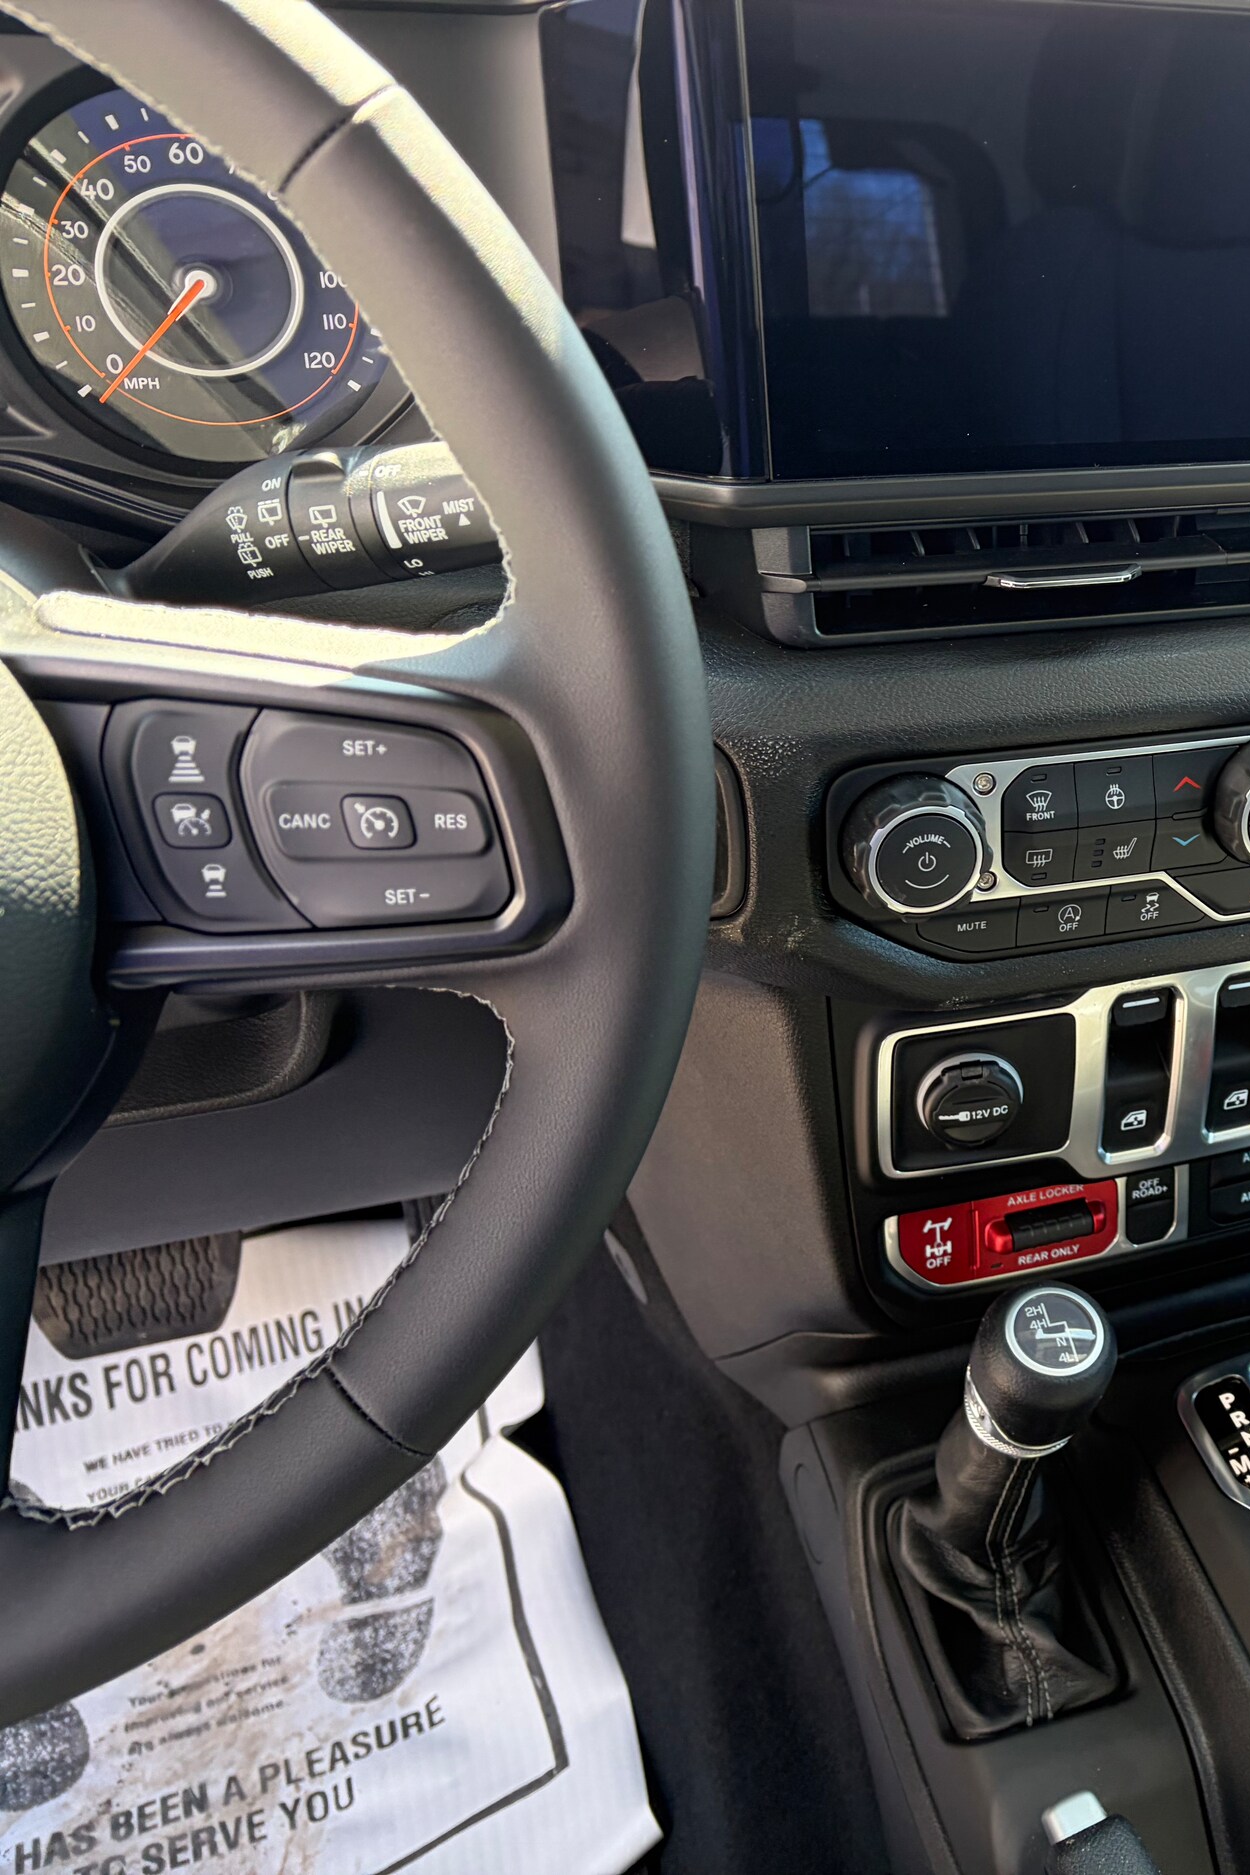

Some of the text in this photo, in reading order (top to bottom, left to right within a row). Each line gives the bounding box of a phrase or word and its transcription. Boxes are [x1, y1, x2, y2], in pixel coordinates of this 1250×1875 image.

[168, 143, 204, 165] 60
[124, 155, 151, 173] 50
[80, 178, 114, 201] 40
[61, 220, 89, 239] 30
[52, 264, 86, 286] 20
[76, 315, 96, 332] 10
[323, 314, 347, 330] 110
[106, 353, 124, 373] 0
[304, 351, 336, 369] 120
[124, 376, 160, 390] MPH
[374, 464, 401, 478] OFF
[261, 477, 281, 491] ON
[443, 498, 475, 514] MIST
[398, 515, 442, 532] FRONT
[231, 533, 254, 544] PULL
[265, 534, 290, 549] OFF
[312, 529, 346, 543] REAR
[403, 529, 448, 545] WIPER
[312, 540, 355, 555] WIPER
[404, 558, 423, 569] LO
[247, 567, 274, 580] PUSH
[342, 740, 387, 757] SET+
[279, 813, 331, 830] CANC
[434, 813, 468, 830] RES
[1026, 809, 1056, 821] FRONT
[905, 833, 946, 850] VOLUME
[1140, 910, 1160, 922] OFF
[957, 921, 987, 932] MUTE
[1059, 921, 1079, 933] OFF
[971, 1105, 1009, 1121] 12V DC
[1138, 1178, 1160, 1190] OFF
[1007, 1184, 1084, 1207] AXLE LOCKER
[1132, 1185, 1168, 1200] ROAD+
[1018, 1244, 1080, 1265] REAR ONLY
[926, 1256, 951, 1270] OFF
[1025, 1305, 1042, 1317] 2H
[1029, 1318, 1049, 1330] 4H
[1056, 1336, 1067, 1347] N
[14, 1371, 94, 1434] NKS
[103, 1352, 176, 1411] FOR
[186, 1309, 325, 1388] COMING
[1218, 1392, 1235, 1411] P
[1229, 1411, 1250, 1428] R
[83, 1422, 223, 1474] WE HAVE TRIED TO
[86, 1482, 129, 1504] YOUR
[15, 1695, 447, 1875] HAS BEEN A PLEASURE
[142, 1806, 269, 1875] SERVE
[278, 1776, 356, 1832] YOU
